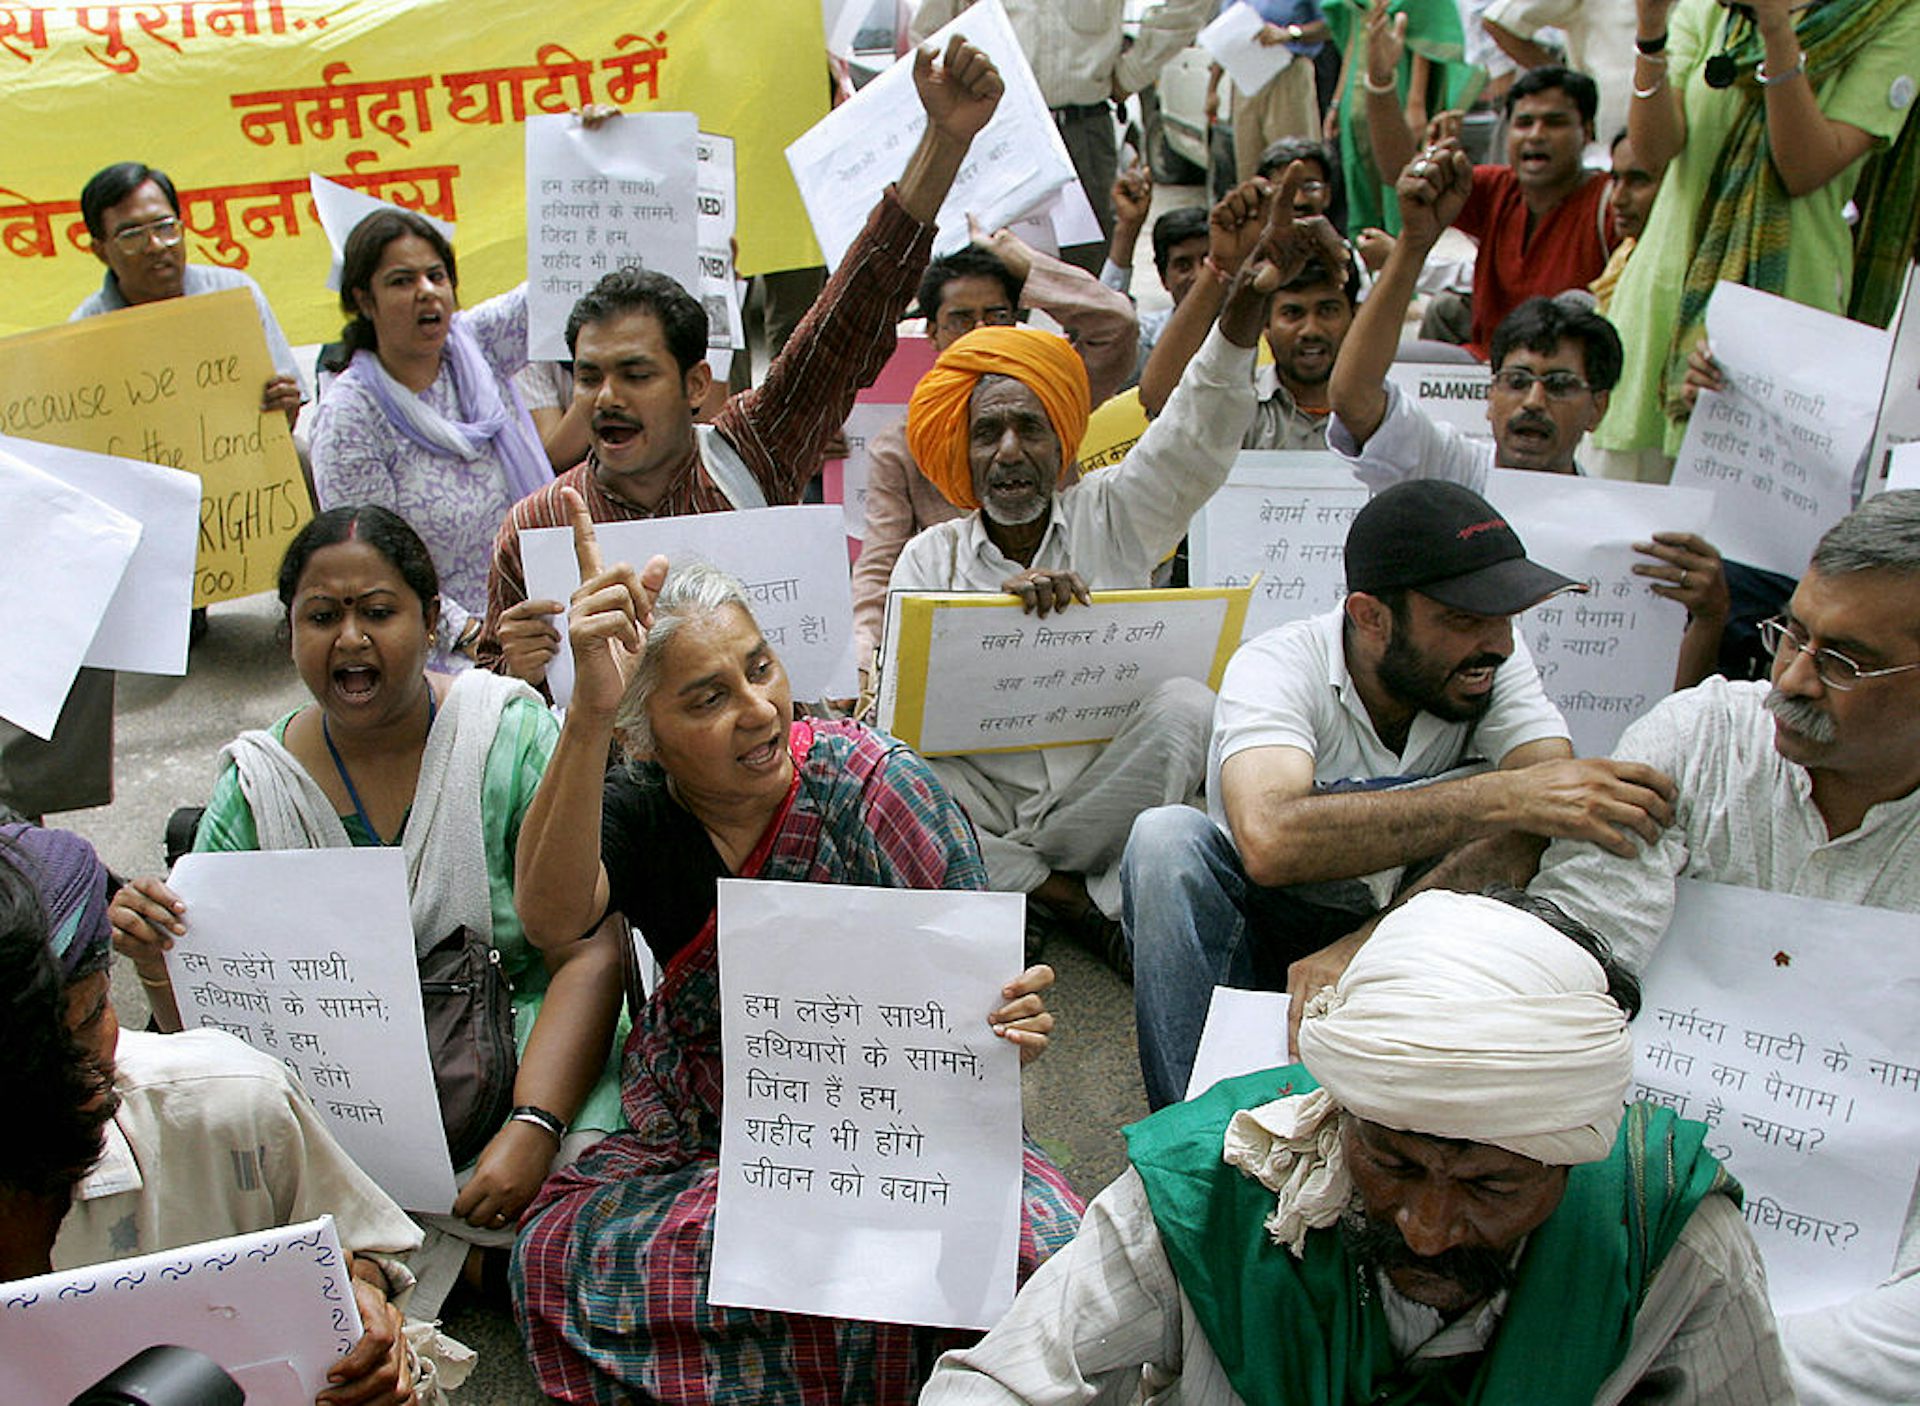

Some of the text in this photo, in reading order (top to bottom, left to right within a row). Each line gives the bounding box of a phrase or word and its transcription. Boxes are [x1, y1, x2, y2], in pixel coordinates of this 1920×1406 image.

[231, 31, 667, 147] नर्मदा घाटी में
[196, 355, 241, 389] are
[200, 478, 299, 554] RIGHTS
[1265, 538, 1290, 563] की
[1032, 626, 1096, 648] मिलकर
[178, 952, 212, 973] हम
[288, 951, 355, 983] साथी,
[190, 981, 391, 1023] हथियारों के सामने;
[743, 994, 953, 1034] हम लड़ेंगे साथी,
[287, 1032, 328, 1057] हम,
[745, 1029, 986, 1081] हथियारों के सामने;
[1645, 1040, 1696, 1077] मौत
[1711, 1062, 1750, 1092] का
[1657, 1007, 1920, 1093] नर्मदा घाटी के नाम
[310, 1060, 352, 1090] होंगे
[745, 1067, 904, 1115] जिंदा हैं हम,
[328, 1098, 386, 1125] बचाने
[1706, 1097, 1726, 1130] है
[1741, 1113, 1826, 1156] न्याय?
[745, 1113, 926, 1158] शहीद भी होंगे
[742, 1156, 951, 1206] जीवन को बचाने
